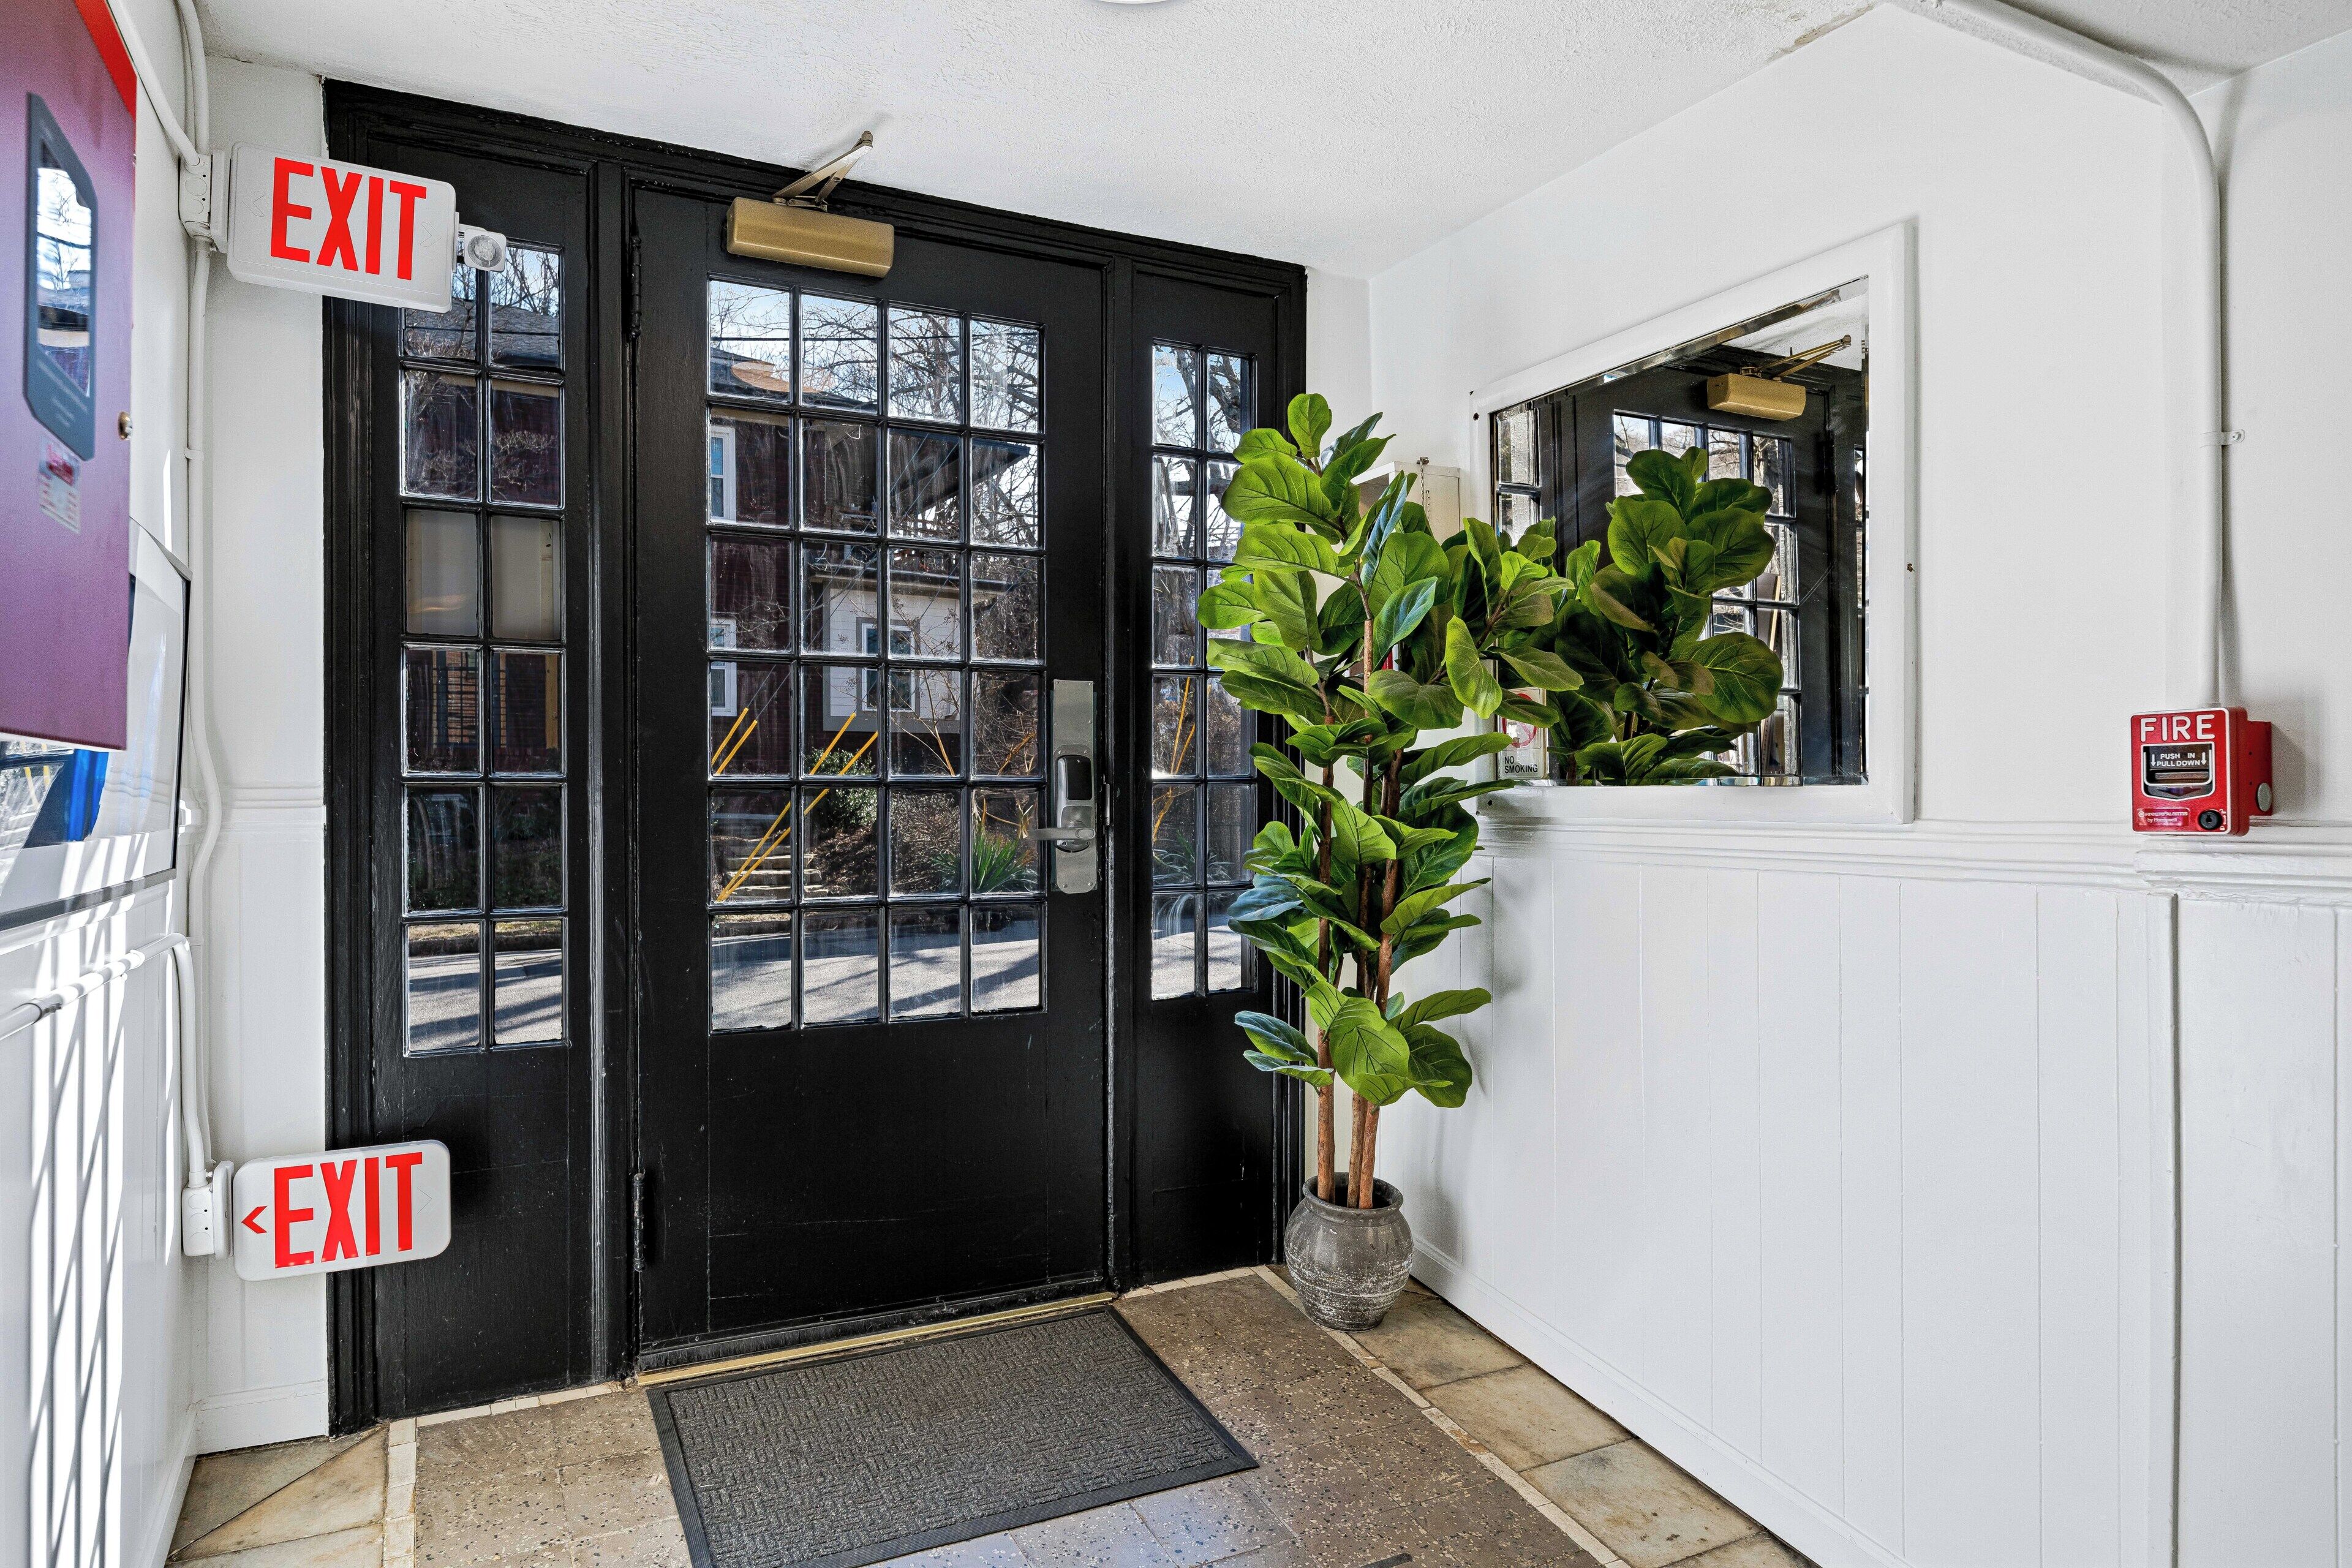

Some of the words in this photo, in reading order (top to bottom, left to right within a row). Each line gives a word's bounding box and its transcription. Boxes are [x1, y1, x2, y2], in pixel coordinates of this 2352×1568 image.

[271, 157, 427, 281] EXIT
[2140, 714, 2215, 742] FIRE
[1504, 764, 1538, 773] SMOKING
[274, 1152, 423, 1269] EXIT
